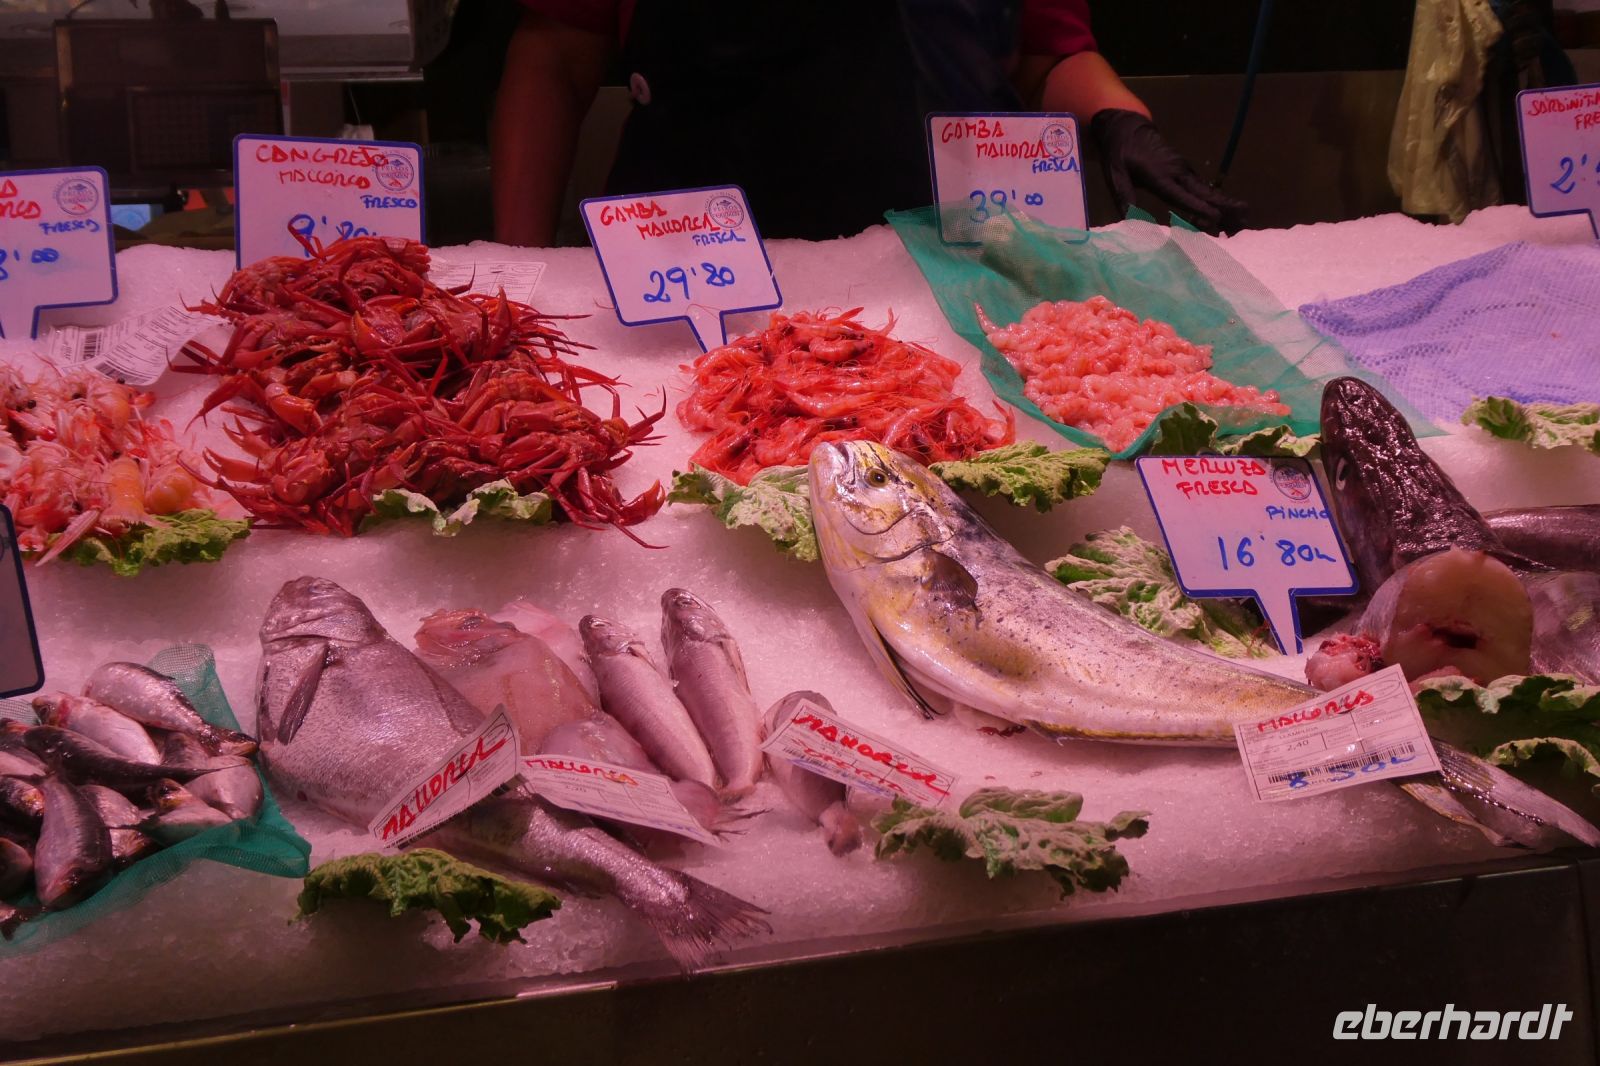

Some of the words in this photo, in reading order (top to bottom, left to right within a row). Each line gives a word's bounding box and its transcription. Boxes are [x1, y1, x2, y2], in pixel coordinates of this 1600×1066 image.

[942, 120, 1004, 143] GAMBA
[1032, 157, 1081, 173] FRESCA
[360, 195, 417, 209] FRESCO
[600, 200, 667, 227] GAMBA
[636, 212, 720, 240] MALLORCA
[692, 229, 746, 247] FRESCA
[643, 262, 735, 302] 29'80
